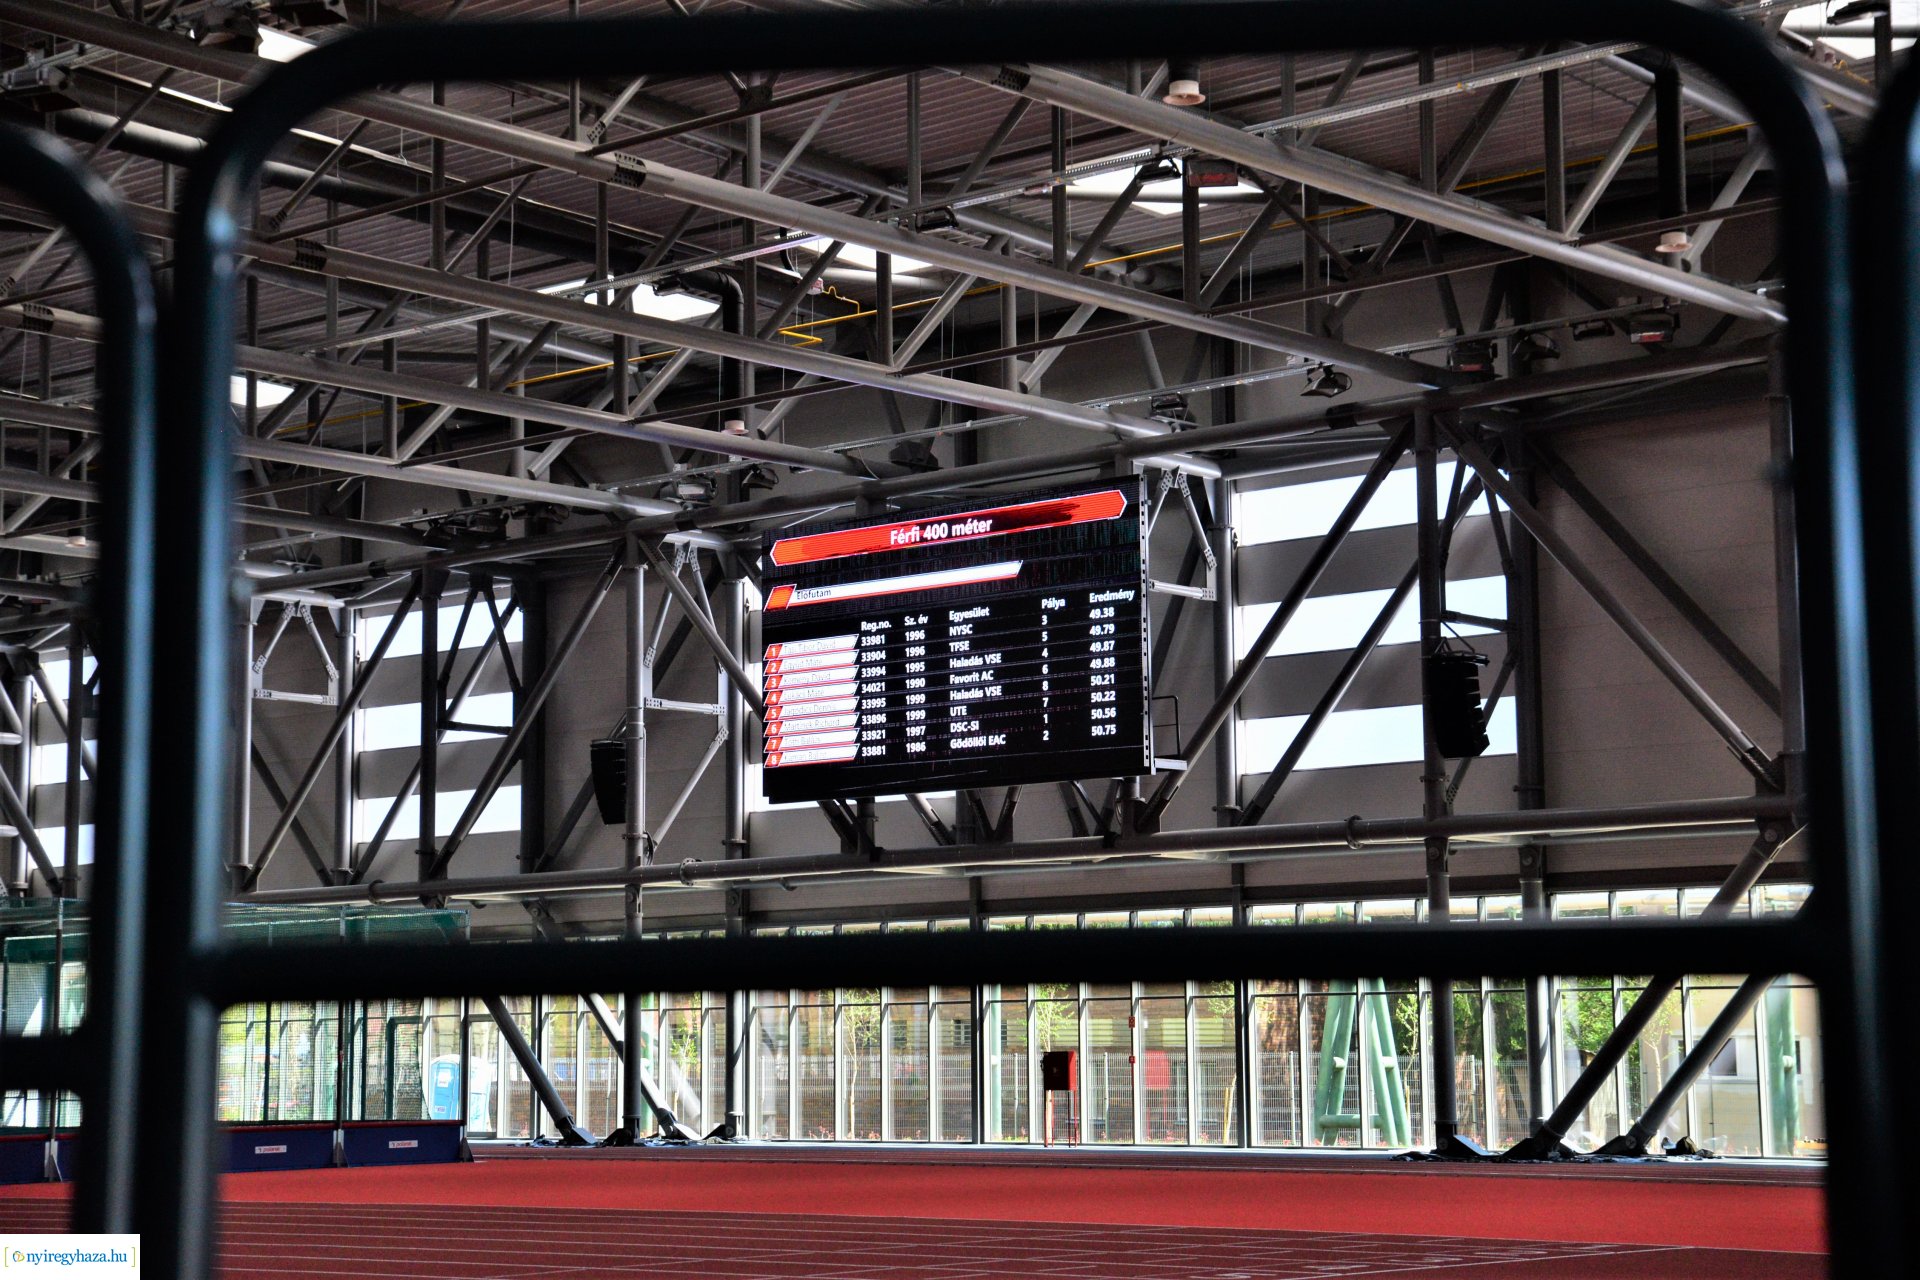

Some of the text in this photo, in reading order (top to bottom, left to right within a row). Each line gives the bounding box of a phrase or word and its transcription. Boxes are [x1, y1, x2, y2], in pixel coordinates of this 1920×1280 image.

[890, 518, 992, 545] Férfi 400 méter
[772, 648, 775, 656] 1
[861, 635, 885, 646] 33981
[905, 630, 925, 641] 1996
[950, 624, 972, 636] NYSC
[1042, 615, 1047, 625] 3
[1089, 607, 1114, 619] 49.38
[861, 589, 1134, 632] Reg.no. Sz. év Egyesület Pálya Eredmény
[771, 663, 776, 672] 2
[861, 650, 886, 662] 33904
[905, 646, 925, 657] 1996
[949, 641, 969, 652] TFSE
[1042, 631, 1047, 641] 5
[1090, 624, 1114, 635] 49.79
[771, 678, 776, 687] 3
[862, 666, 886, 677] 33994
[905, 662, 925, 673] 1995
[950, 656, 983, 668] Haladás
[985, 653, 1001, 664] VSE
[1042, 648, 1048, 657] 4
[1090, 640, 1115, 652] 49.87
[771, 694, 776, 702] 4
[862, 682, 885, 693] 34021
[906, 678, 925, 688] 1990
[950, 672, 979, 684] Favorit
[981, 670, 993, 681] AC
[1042, 664, 1048, 674] 6
[1090, 657, 1115, 669] 49.88
[771, 709, 776, 718] 5
[862, 698, 886, 709] 33995
[906, 694, 925, 705] 1999
[950, 688, 983, 700] Haladás
[985, 686, 1002, 696] VSE
[1042, 681, 1048, 691] 8
[1091, 674, 1114, 686] 50.21
[771, 724, 777, 733] 6
[906, 710, 925, 720] 1999
[950, 706, 967, 716] UTE
[1043, 697, 1048, 707] 7
[1091, 691, 1115, 702] 50.22
[771, 741, 776, 749] 7
[862, 730, 885, 741] 33921
[906, 726, 926, 736] 1997
[1043, 714, 1048, 723] 1
[1091, 707, 1116, 719] 50.56
[771, 755, 777, 764] 8
[906, 742, 926, 752] 1986
[950, 736, 986, 749] Gödöllői
[989, 734, 1006, 745] EAC
[1043, 730, 1049, 740] 2
[1092, 724, 1116, 736] 50.75
